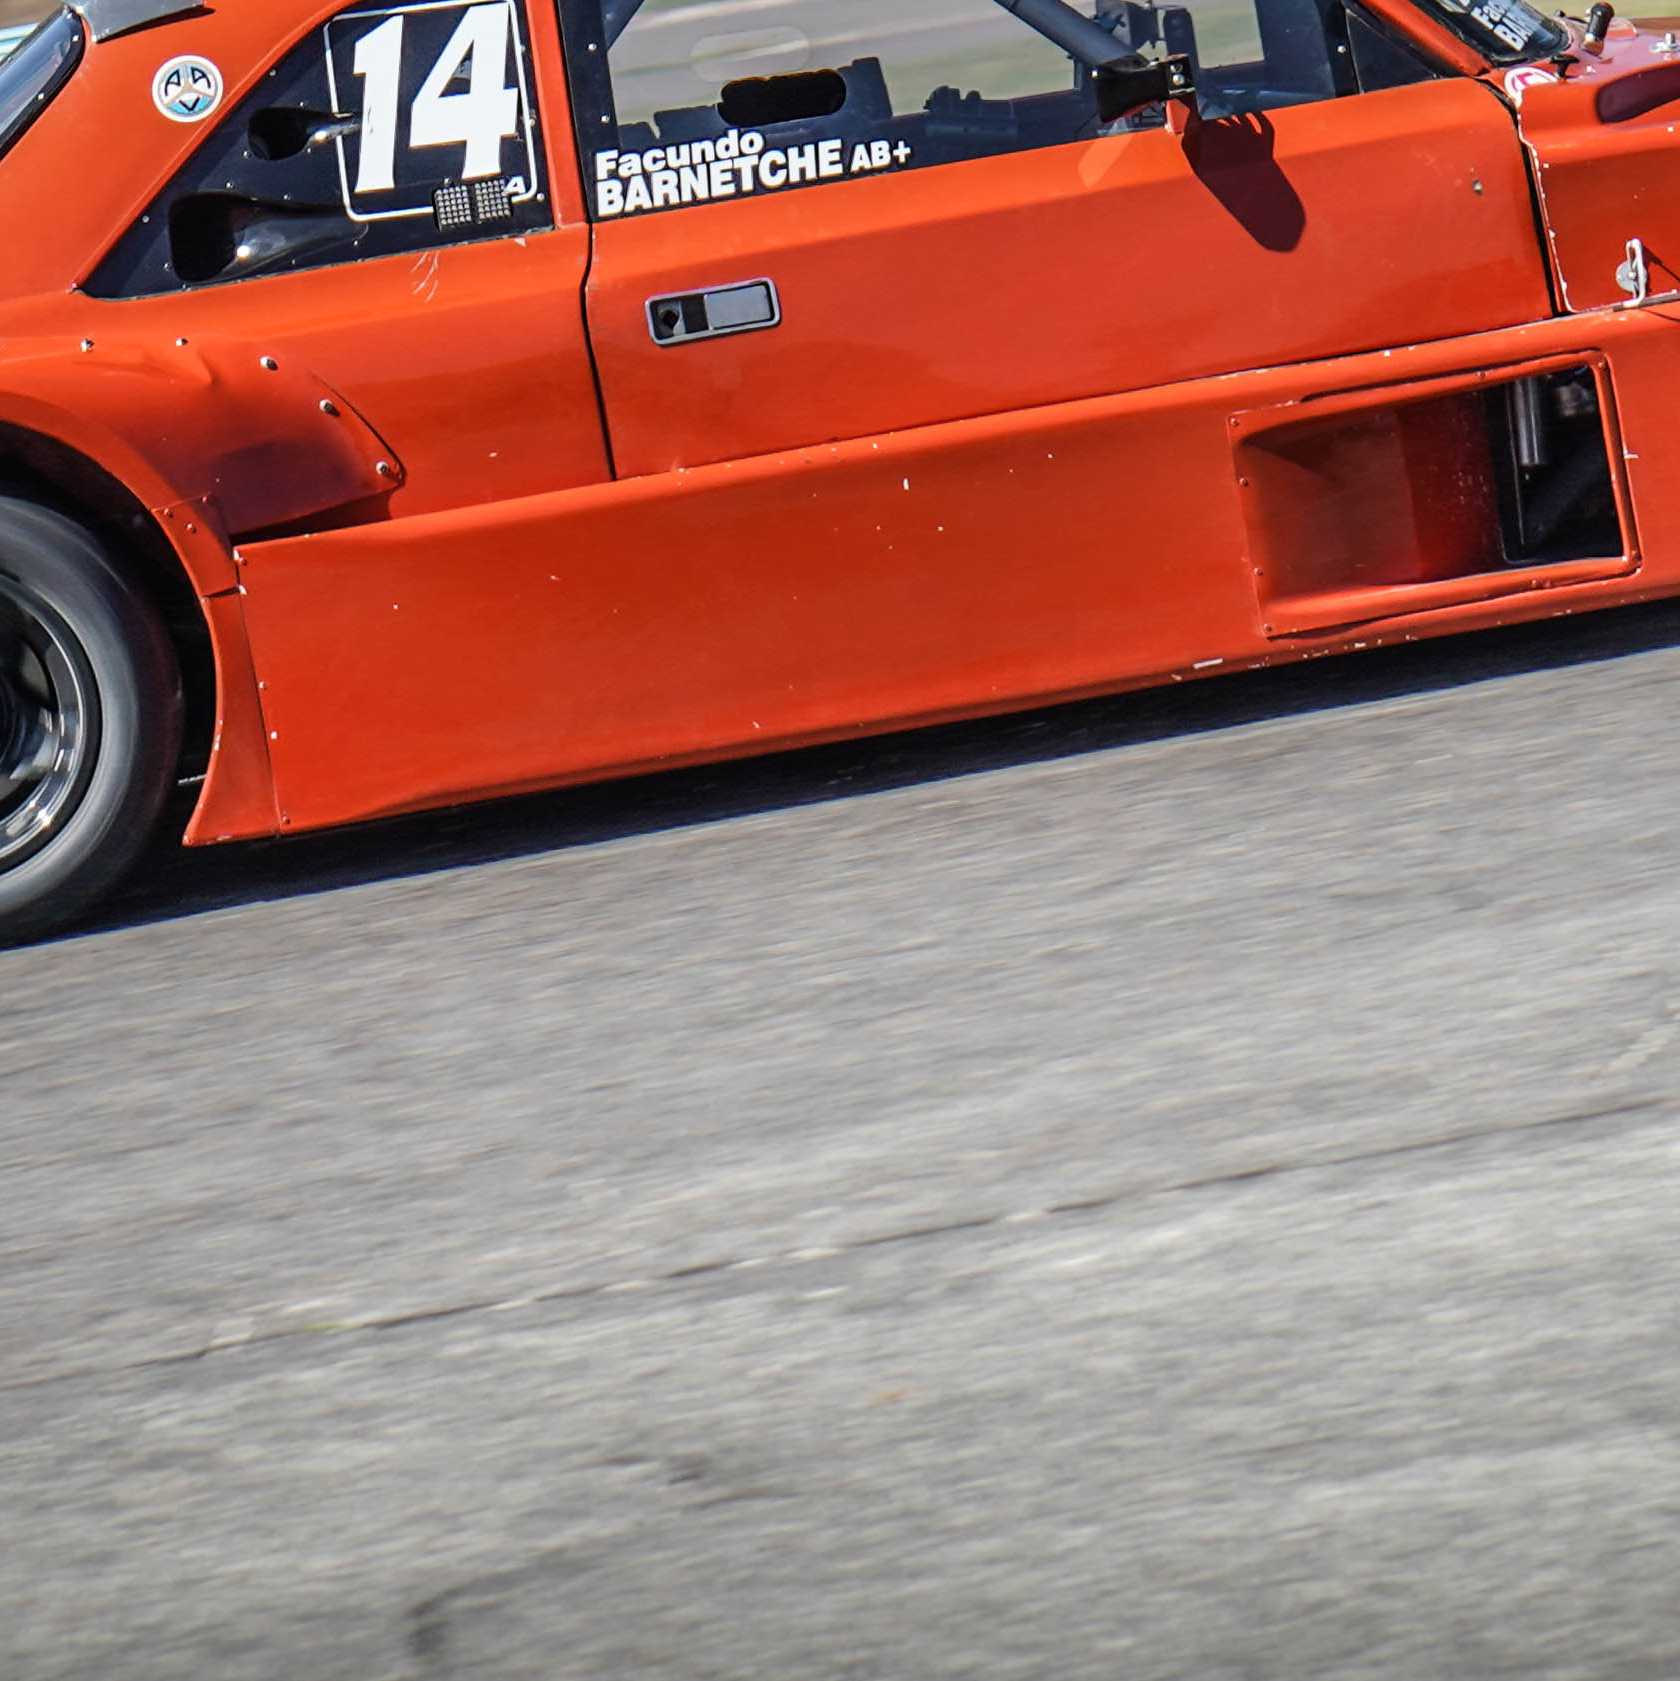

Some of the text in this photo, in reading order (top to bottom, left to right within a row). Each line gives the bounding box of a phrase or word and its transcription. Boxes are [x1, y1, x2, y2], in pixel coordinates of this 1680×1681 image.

[353, 2, 520, 194] 14
[595, 128, 765, 181] Facundo
[596, 138, 912, 217] BARNETCHE AB+
